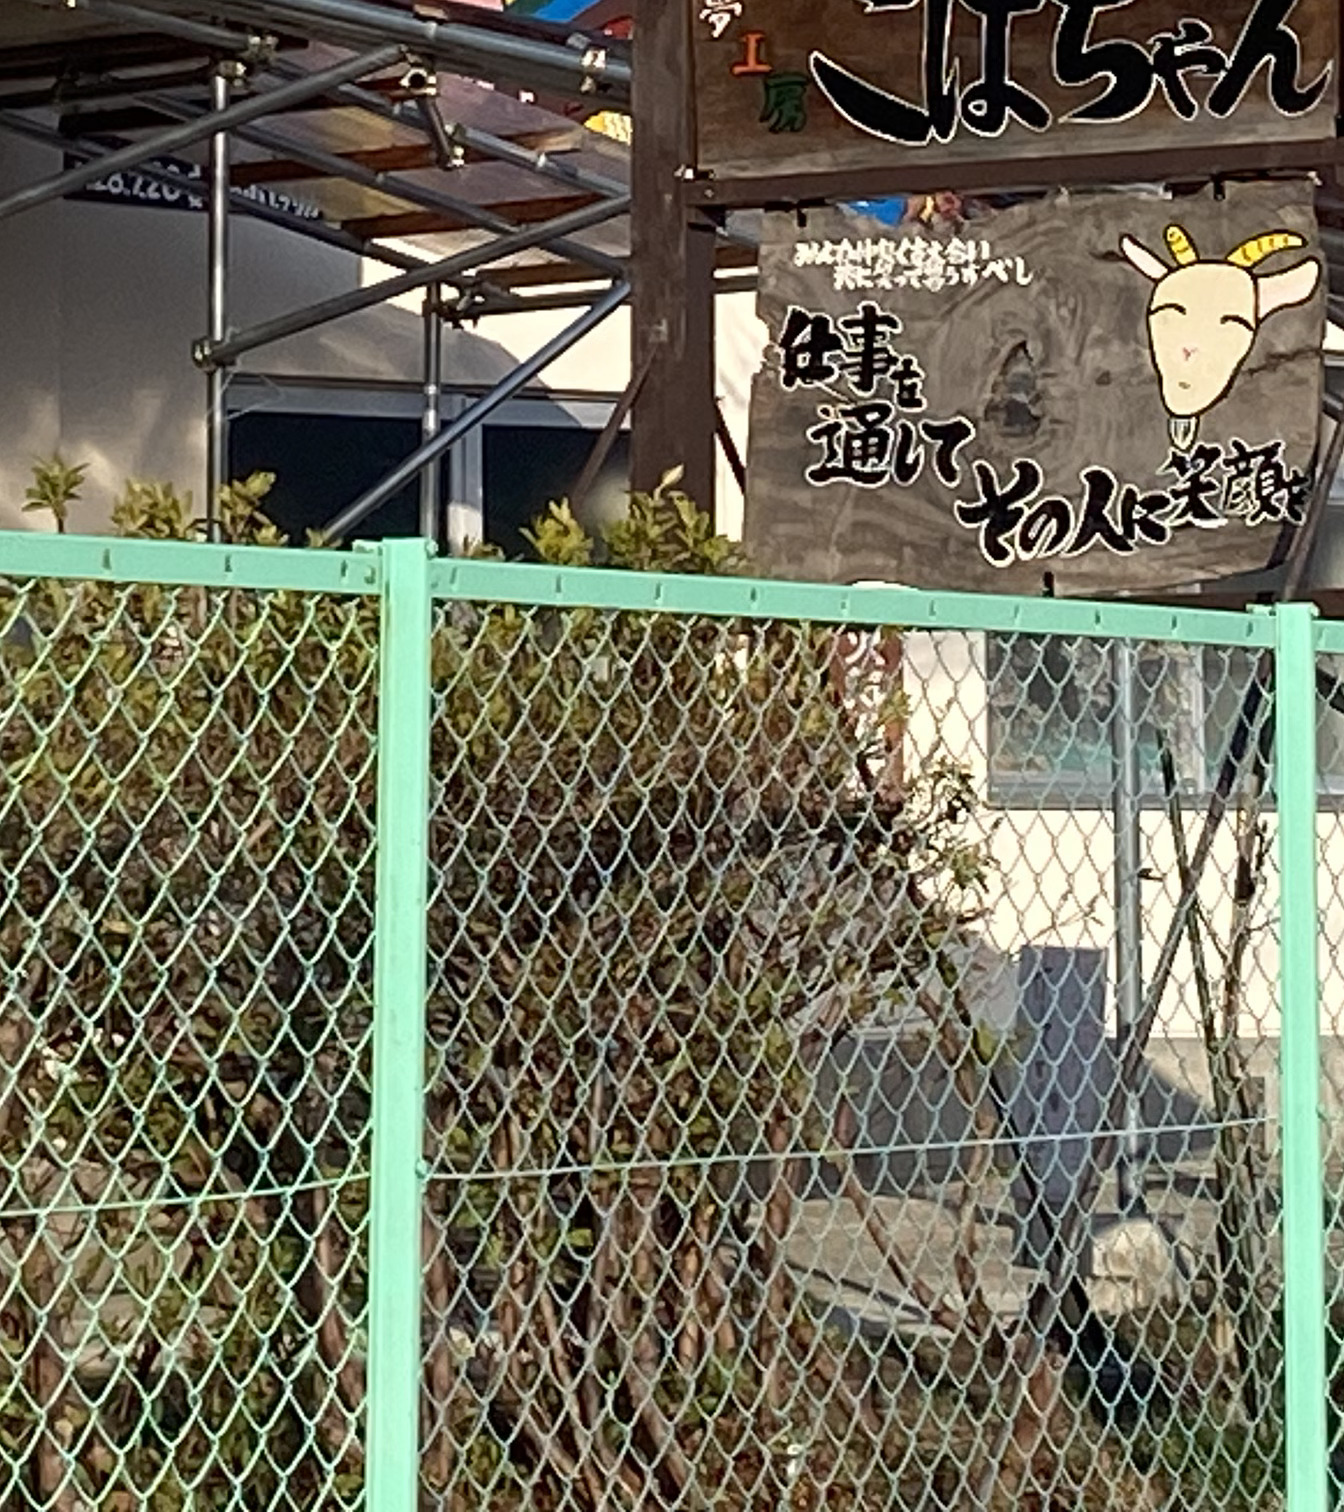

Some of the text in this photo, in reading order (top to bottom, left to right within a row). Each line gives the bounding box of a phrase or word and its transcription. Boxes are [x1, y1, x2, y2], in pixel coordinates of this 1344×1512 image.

[778, 301, 928, 413] 仕事を
[805, 399, 976, 489] 通して
